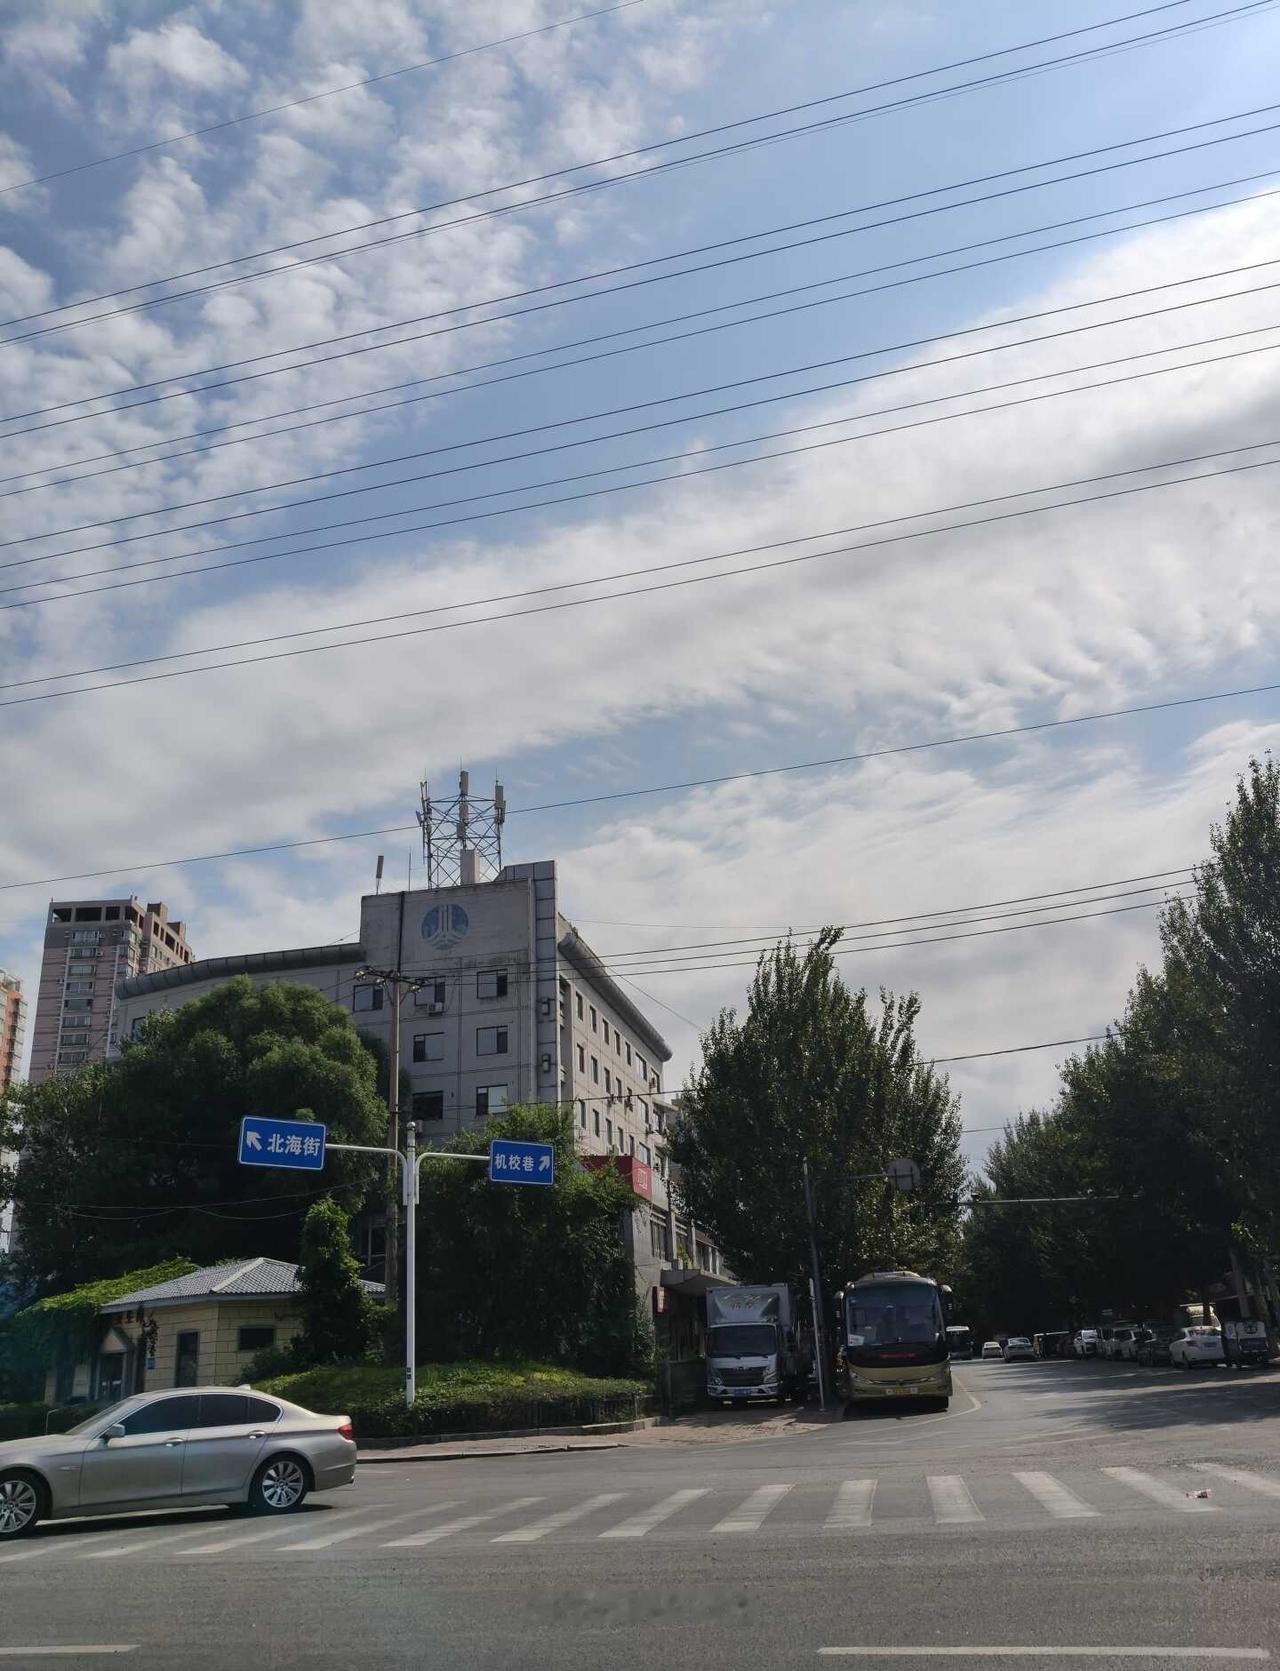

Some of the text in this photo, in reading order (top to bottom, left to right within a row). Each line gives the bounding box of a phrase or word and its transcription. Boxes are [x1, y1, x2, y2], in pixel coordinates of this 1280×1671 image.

[267, 1133, 320, 1156] 北海街
[494, 1153, 534, 1172] 机校巷
